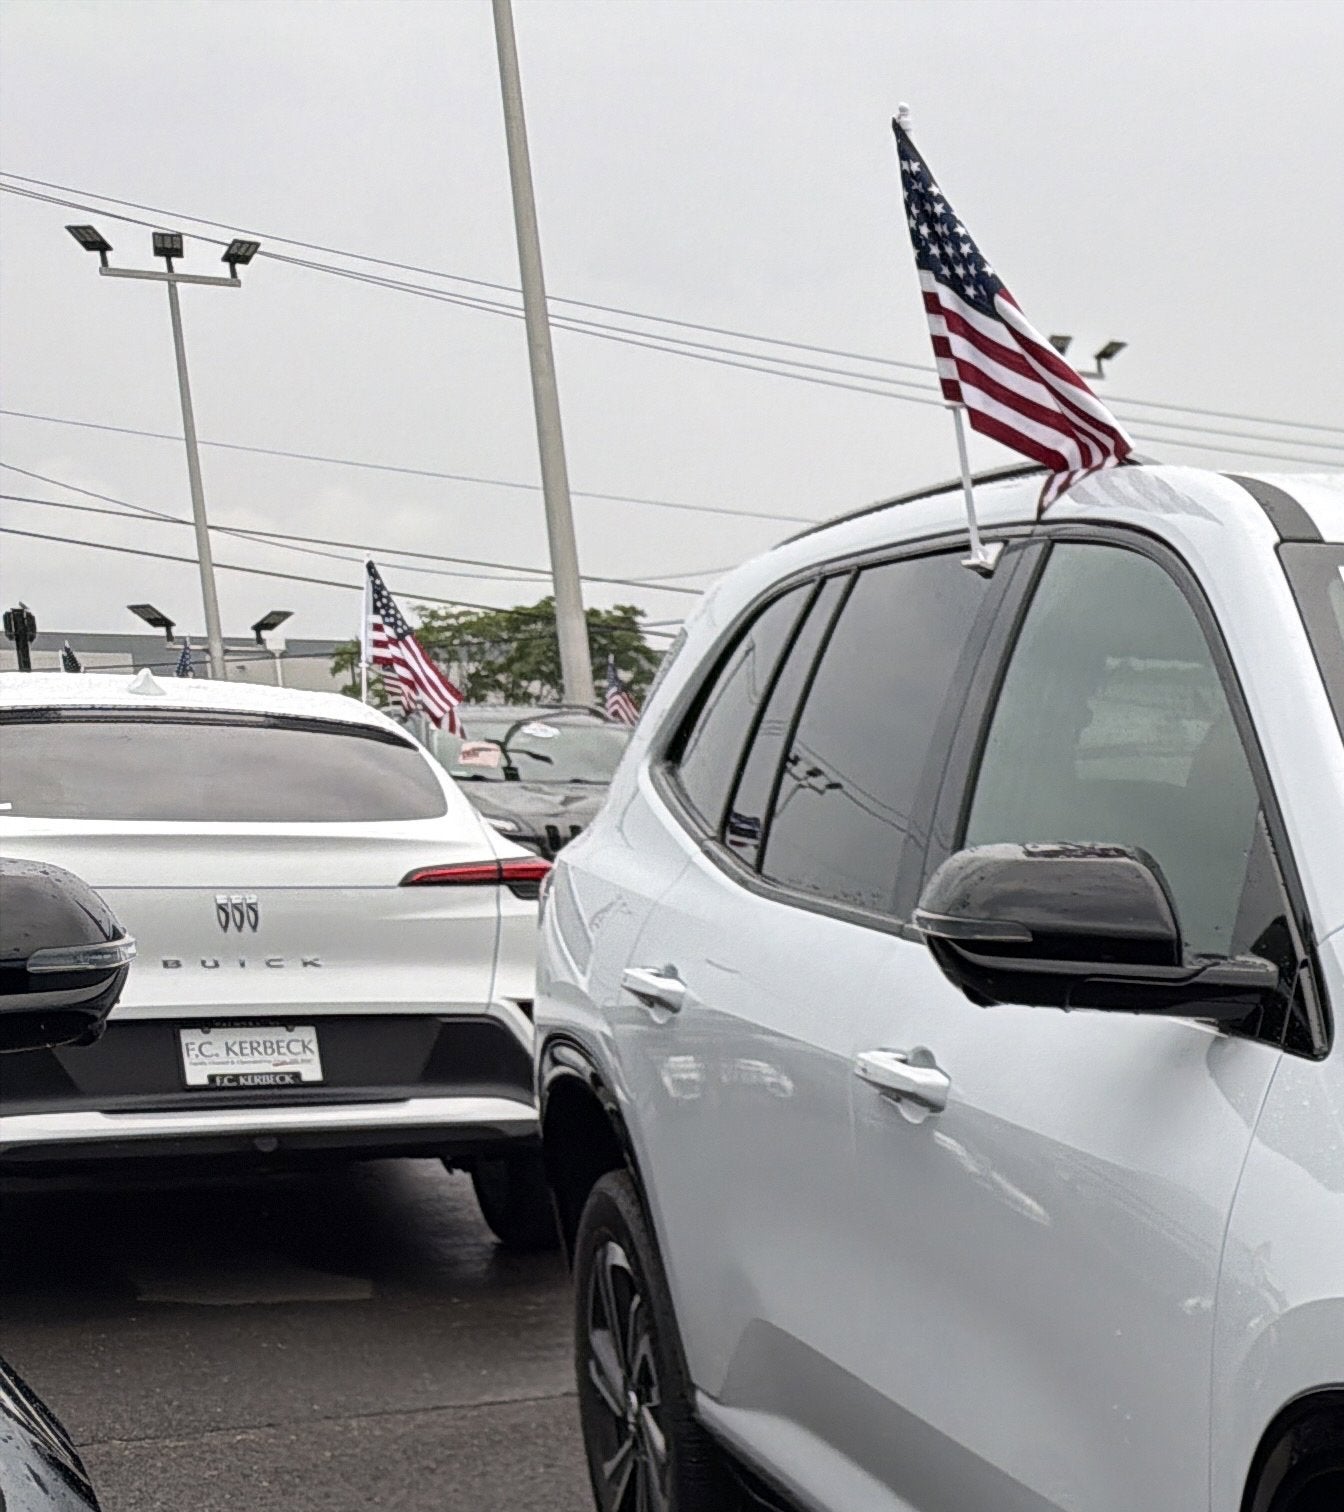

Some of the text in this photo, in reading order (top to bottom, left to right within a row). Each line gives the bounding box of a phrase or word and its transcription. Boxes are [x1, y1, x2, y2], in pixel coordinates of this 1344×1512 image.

[162, 957, 323, 969] BUICK
[185, 1038, 315, 1059] F.C. KERBECK
